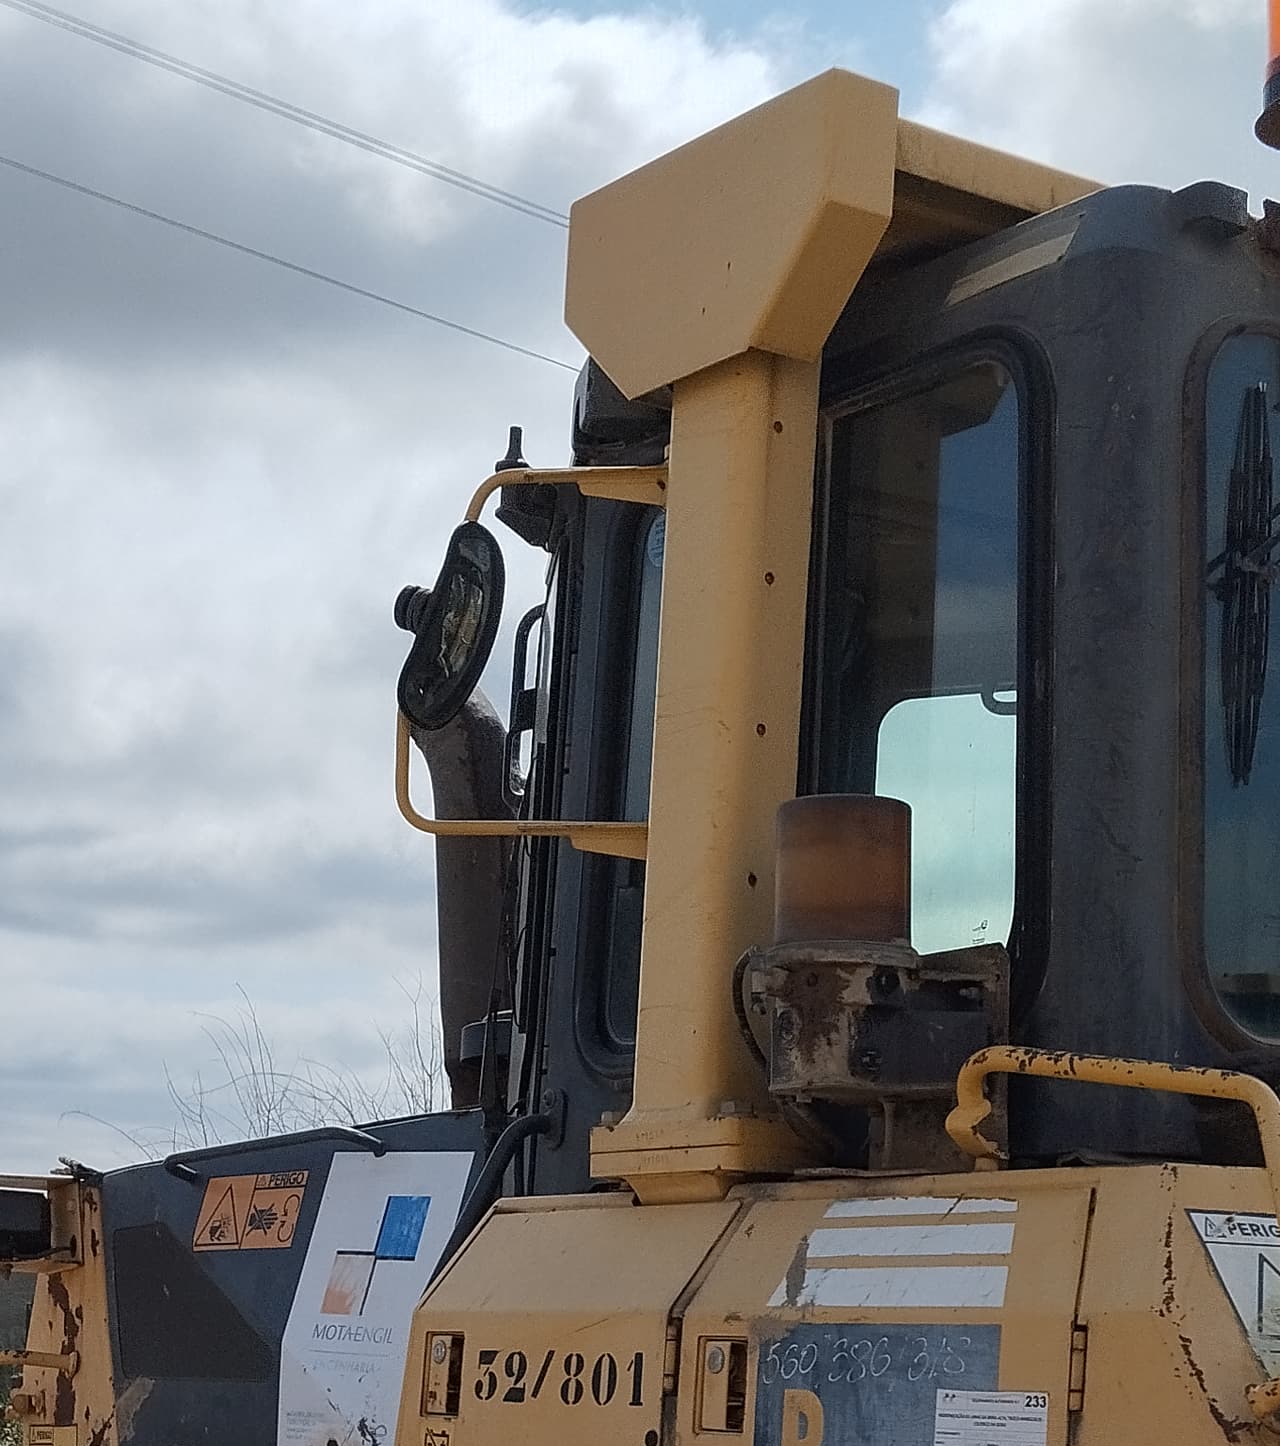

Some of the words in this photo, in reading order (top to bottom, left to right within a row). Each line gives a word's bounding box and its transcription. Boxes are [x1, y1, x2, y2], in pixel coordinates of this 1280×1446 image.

[267, 1171, 305, 1187] PERIGO
[474, 1349, 644, 1407] 32/801
[1024, 1395, 1047, 1409] 233
